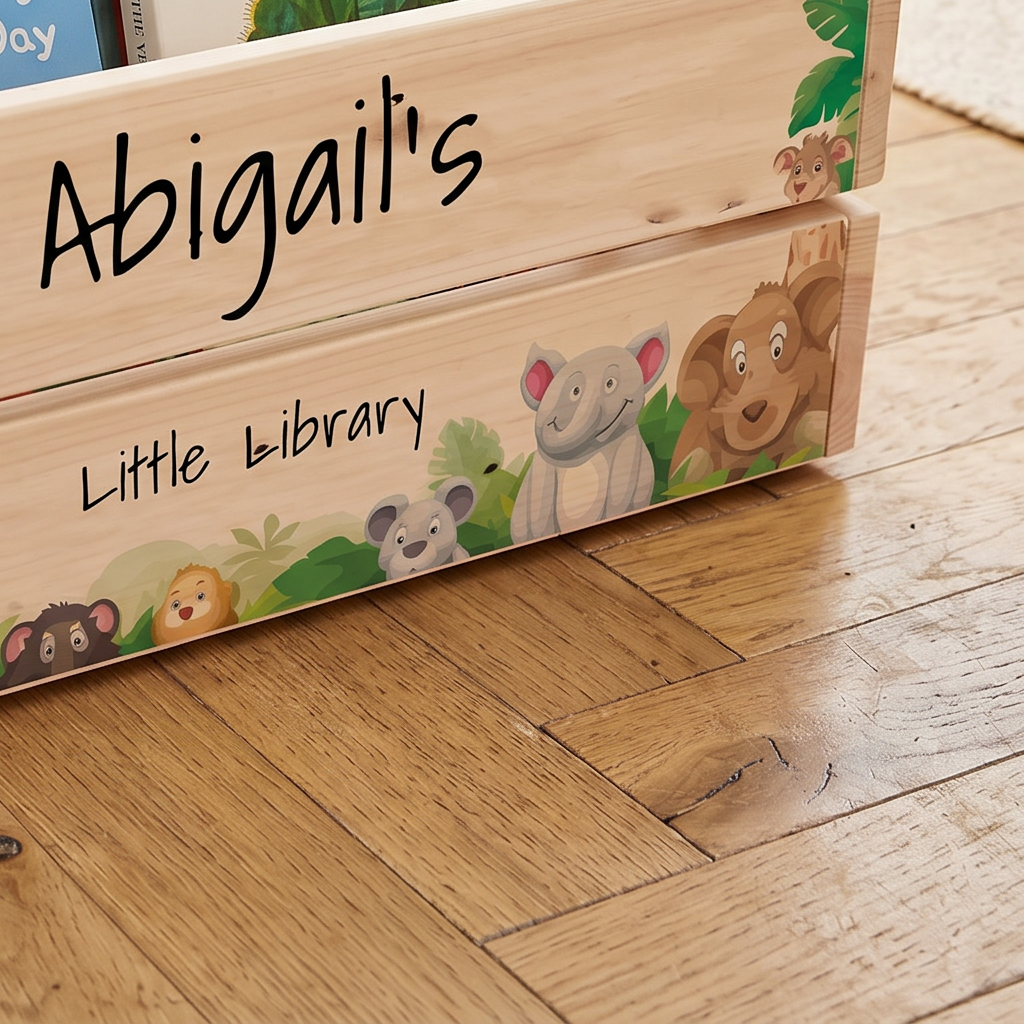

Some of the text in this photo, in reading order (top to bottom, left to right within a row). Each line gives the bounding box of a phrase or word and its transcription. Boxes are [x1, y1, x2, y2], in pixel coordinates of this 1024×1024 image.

[40, 74, 483, 321] Abigail's
[81, 388, 426, 512] Little Library
